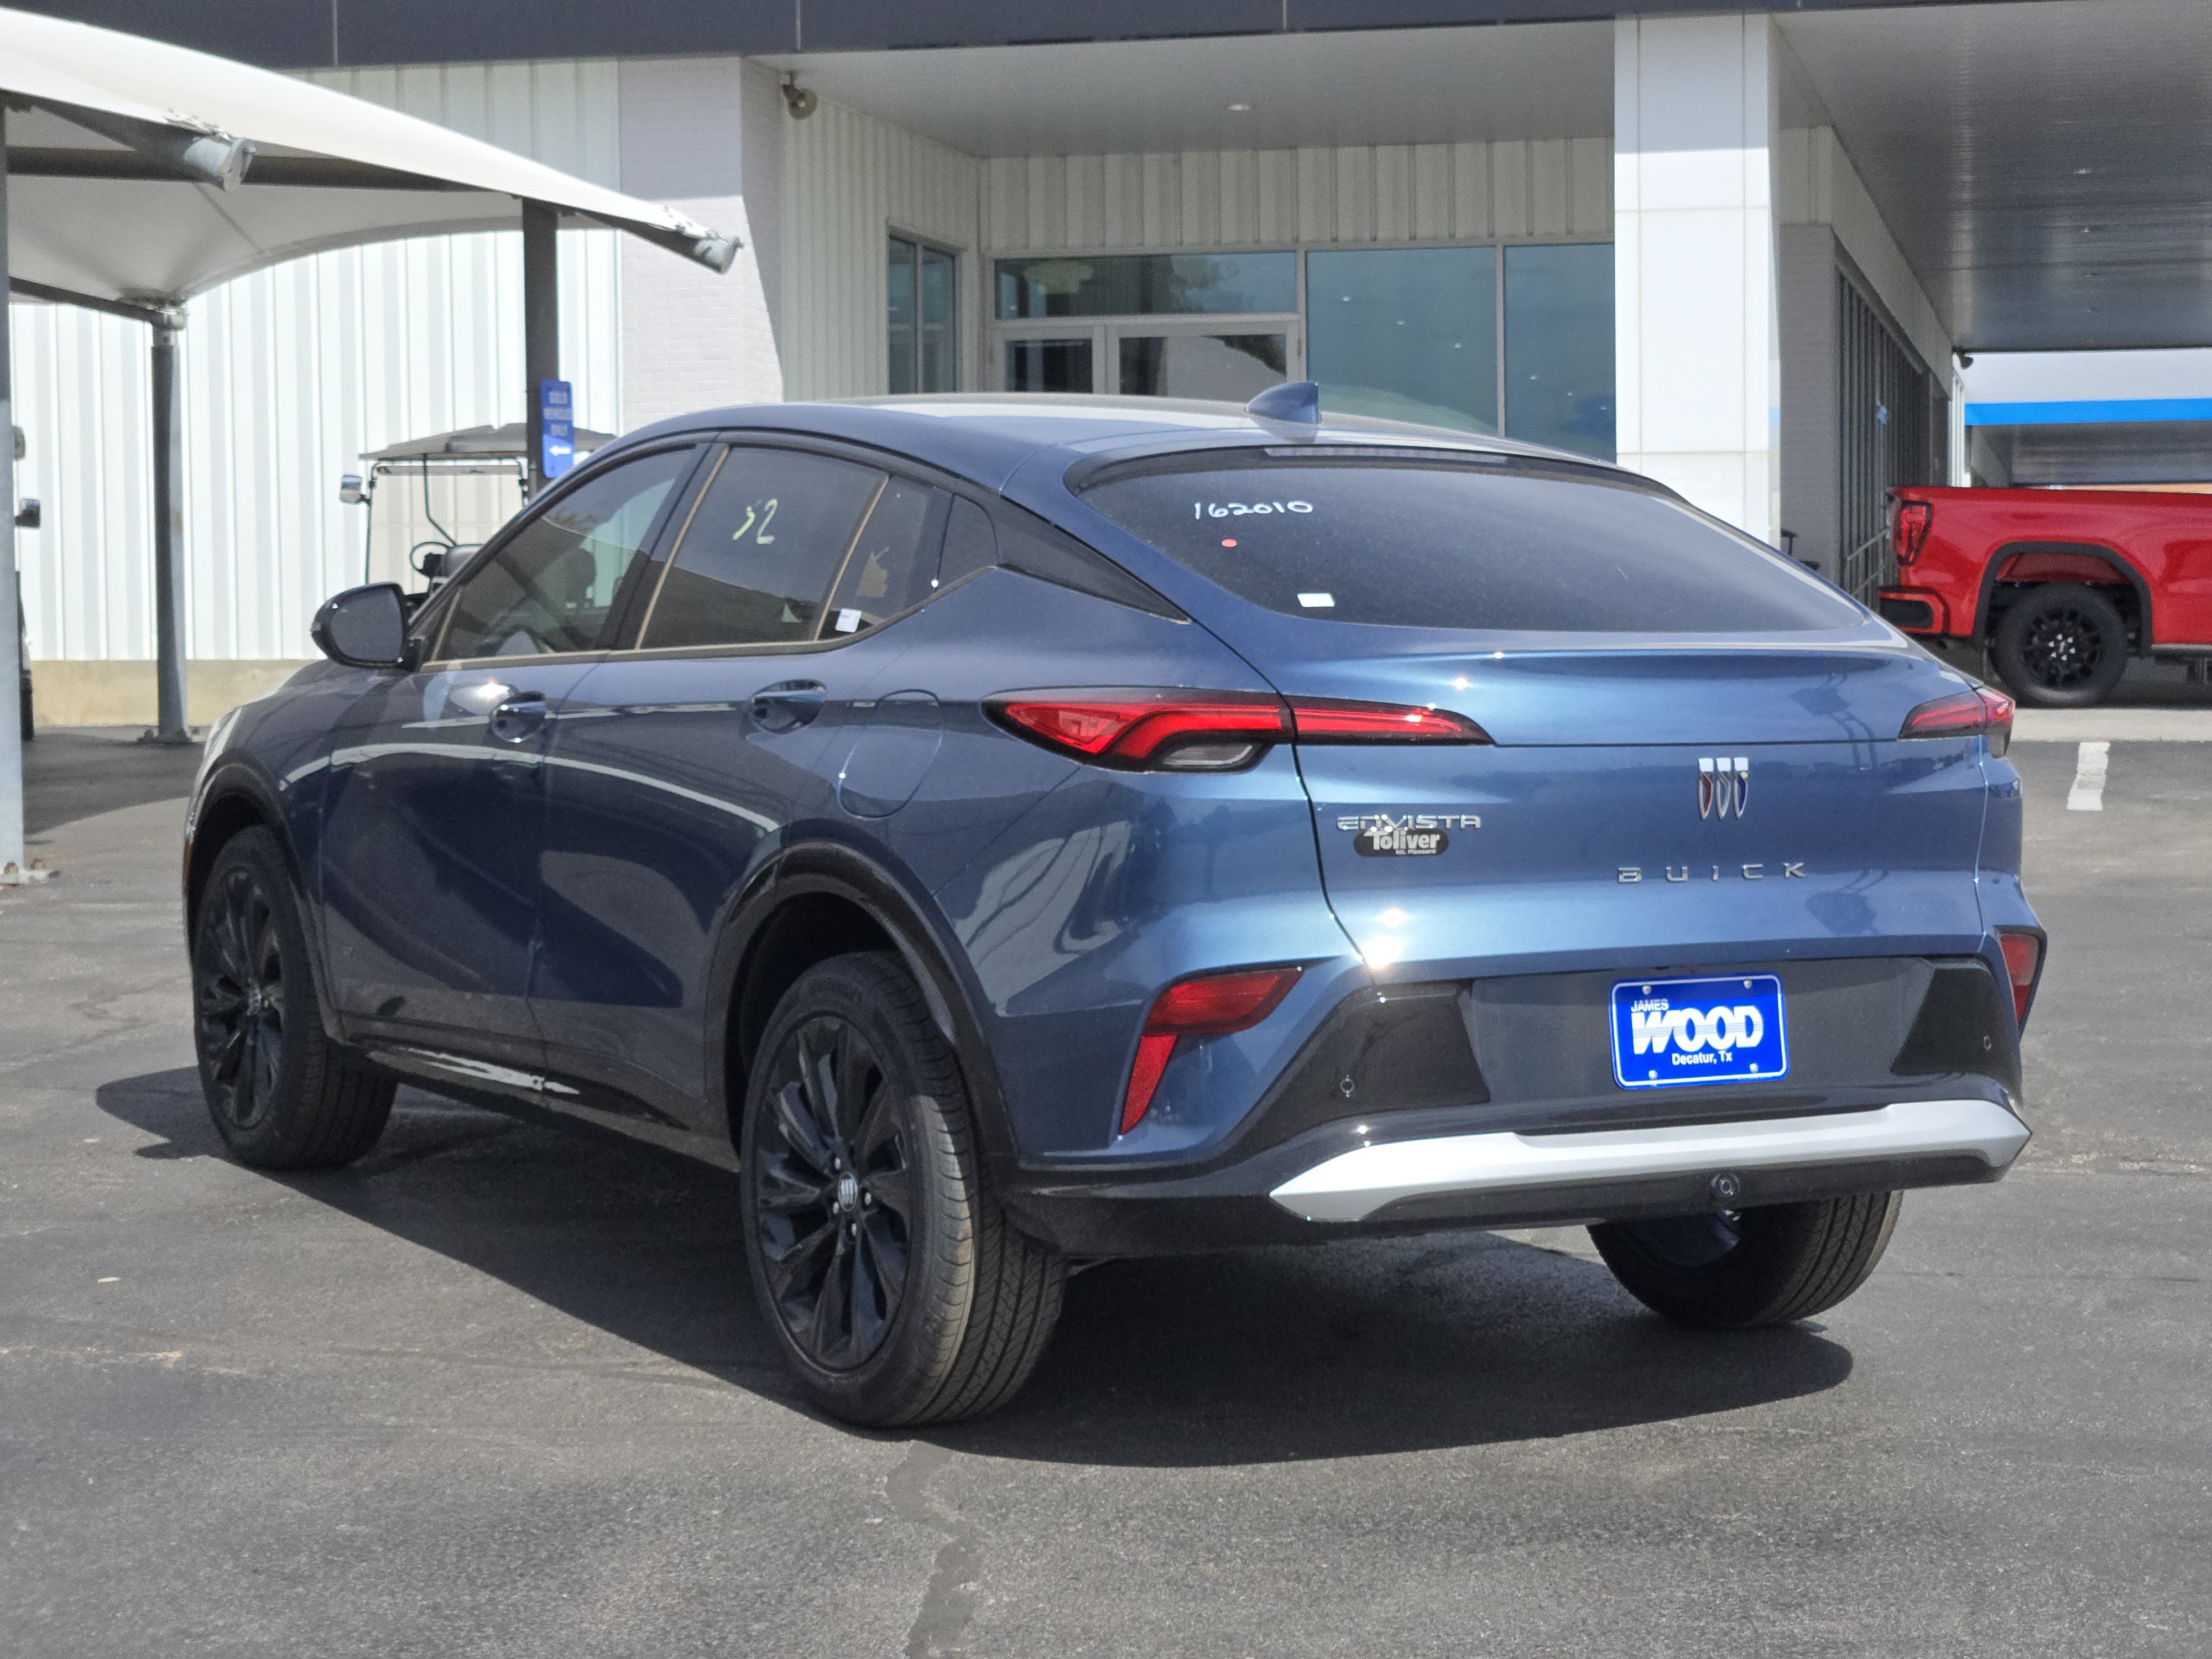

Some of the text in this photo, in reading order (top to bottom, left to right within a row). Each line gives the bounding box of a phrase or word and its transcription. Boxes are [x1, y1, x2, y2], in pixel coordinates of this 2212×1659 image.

[1194, 500, 1313, 520] 162010
[1337, 815, 1481, 830] ENVISTA
[1364, 828, 1441, 850] Toliver
[1618, 862, 1806, 883] BUICK
[1631, 998, 1670, 1013] JAMES
[1631, 1005, 1764, 1055] WOOD
[1672, 1051, 1733, 1066] Decatur, Tx
